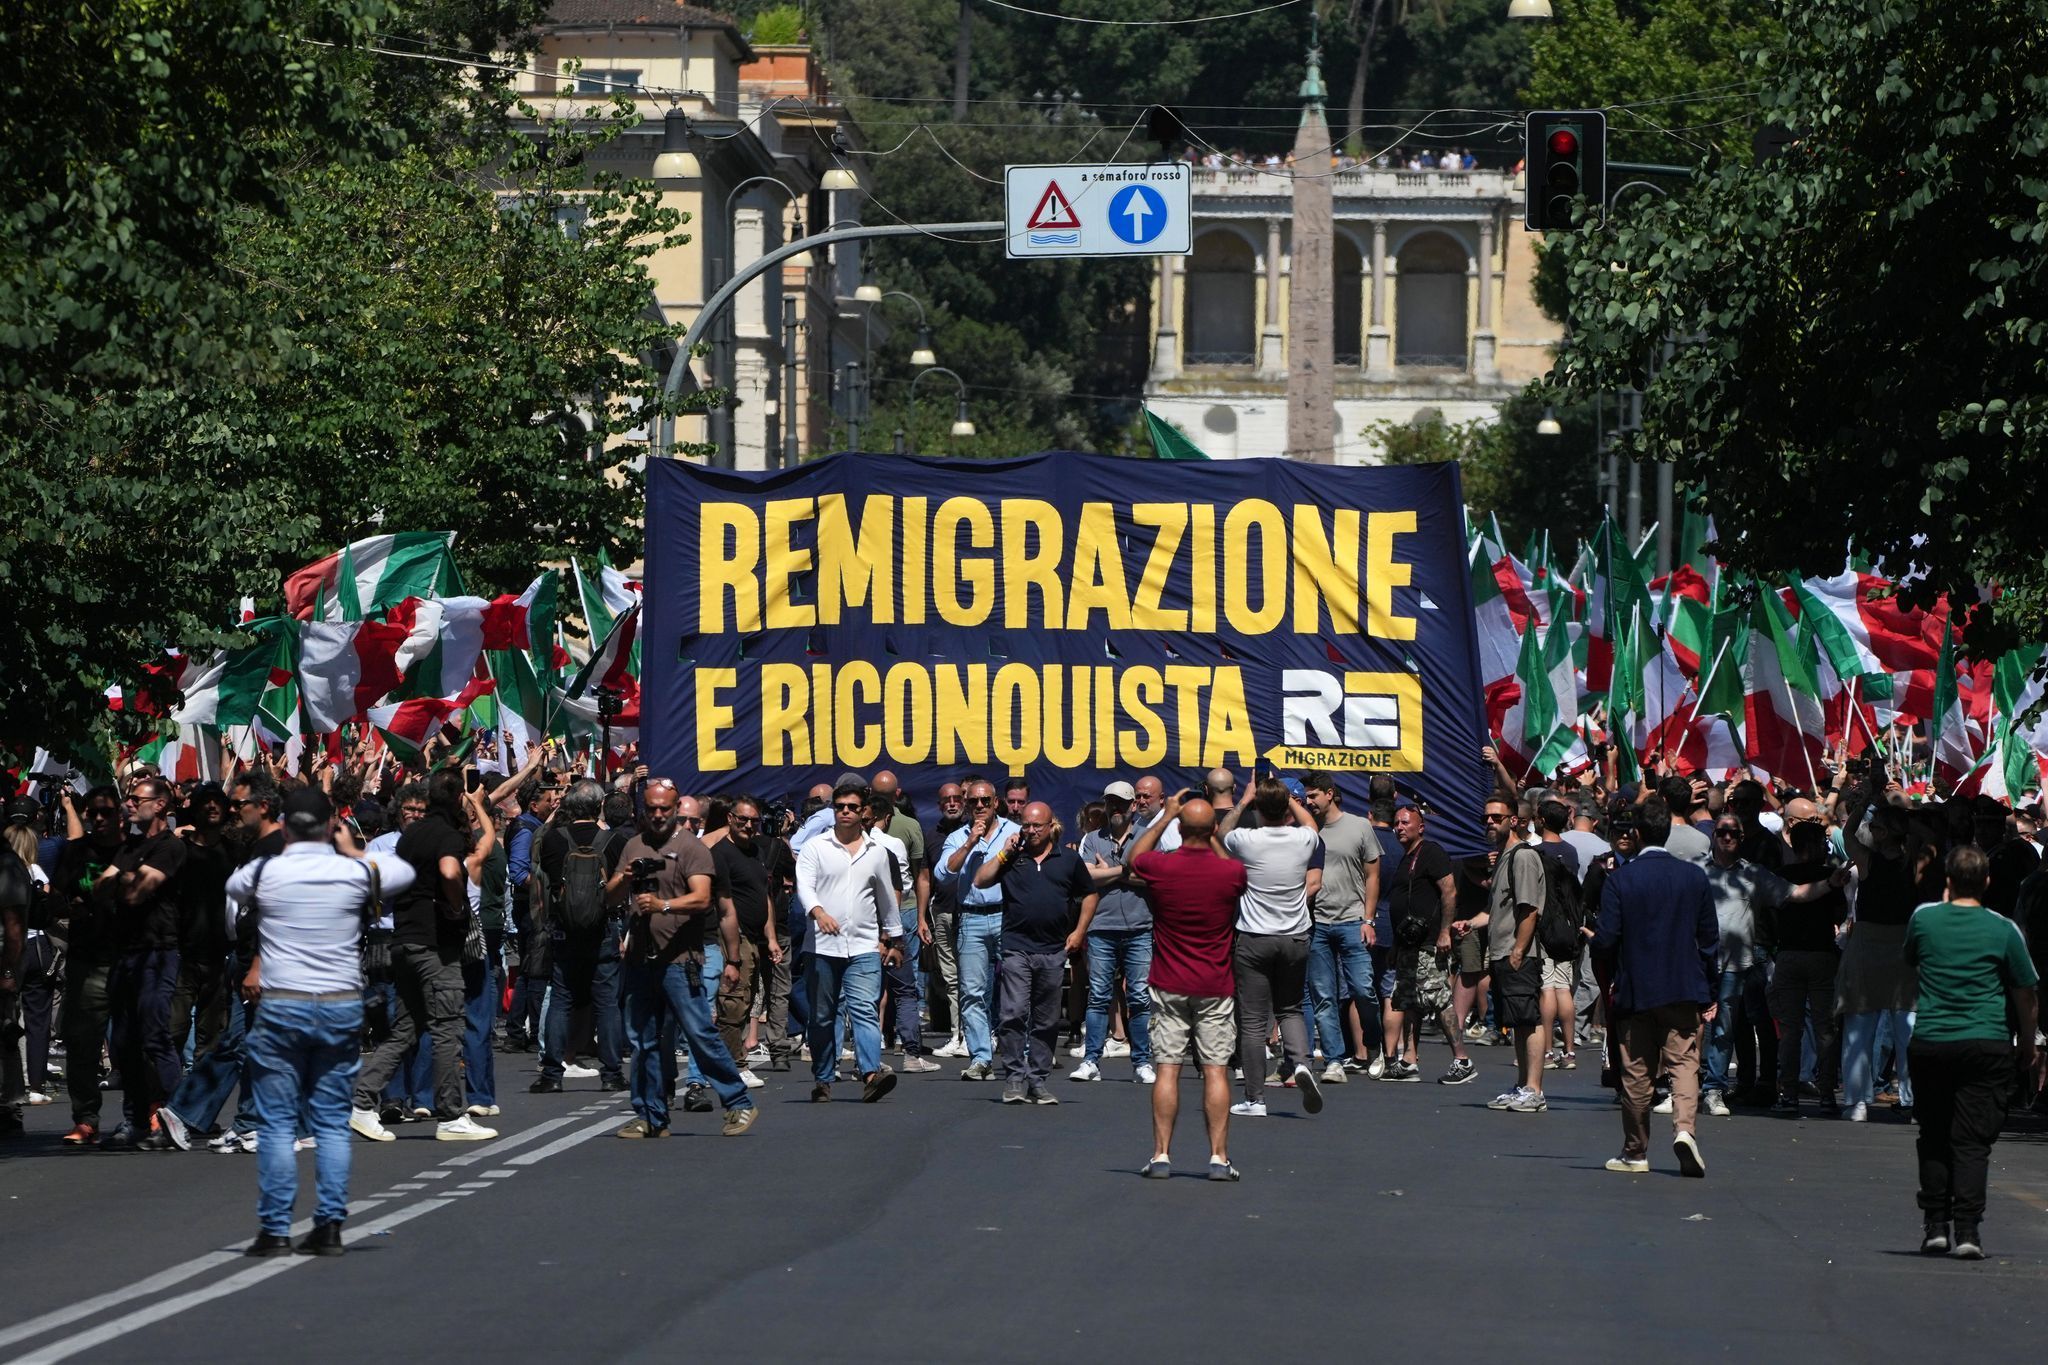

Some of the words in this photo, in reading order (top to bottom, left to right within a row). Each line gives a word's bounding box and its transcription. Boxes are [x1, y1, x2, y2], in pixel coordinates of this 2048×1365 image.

[1081, 174, 1088, 182] a
[1093, 170, 1146, 182] semaforo
[1151, 171, 1181, 181] rosso
[699, 493, 1418, 641] REMIGRAZIONE
[695, 667, 737, 772] E
[761, 660, 1258, 777] RICONQUISTA
[1285, 750, 1392, 768] MIGRAZIONE
